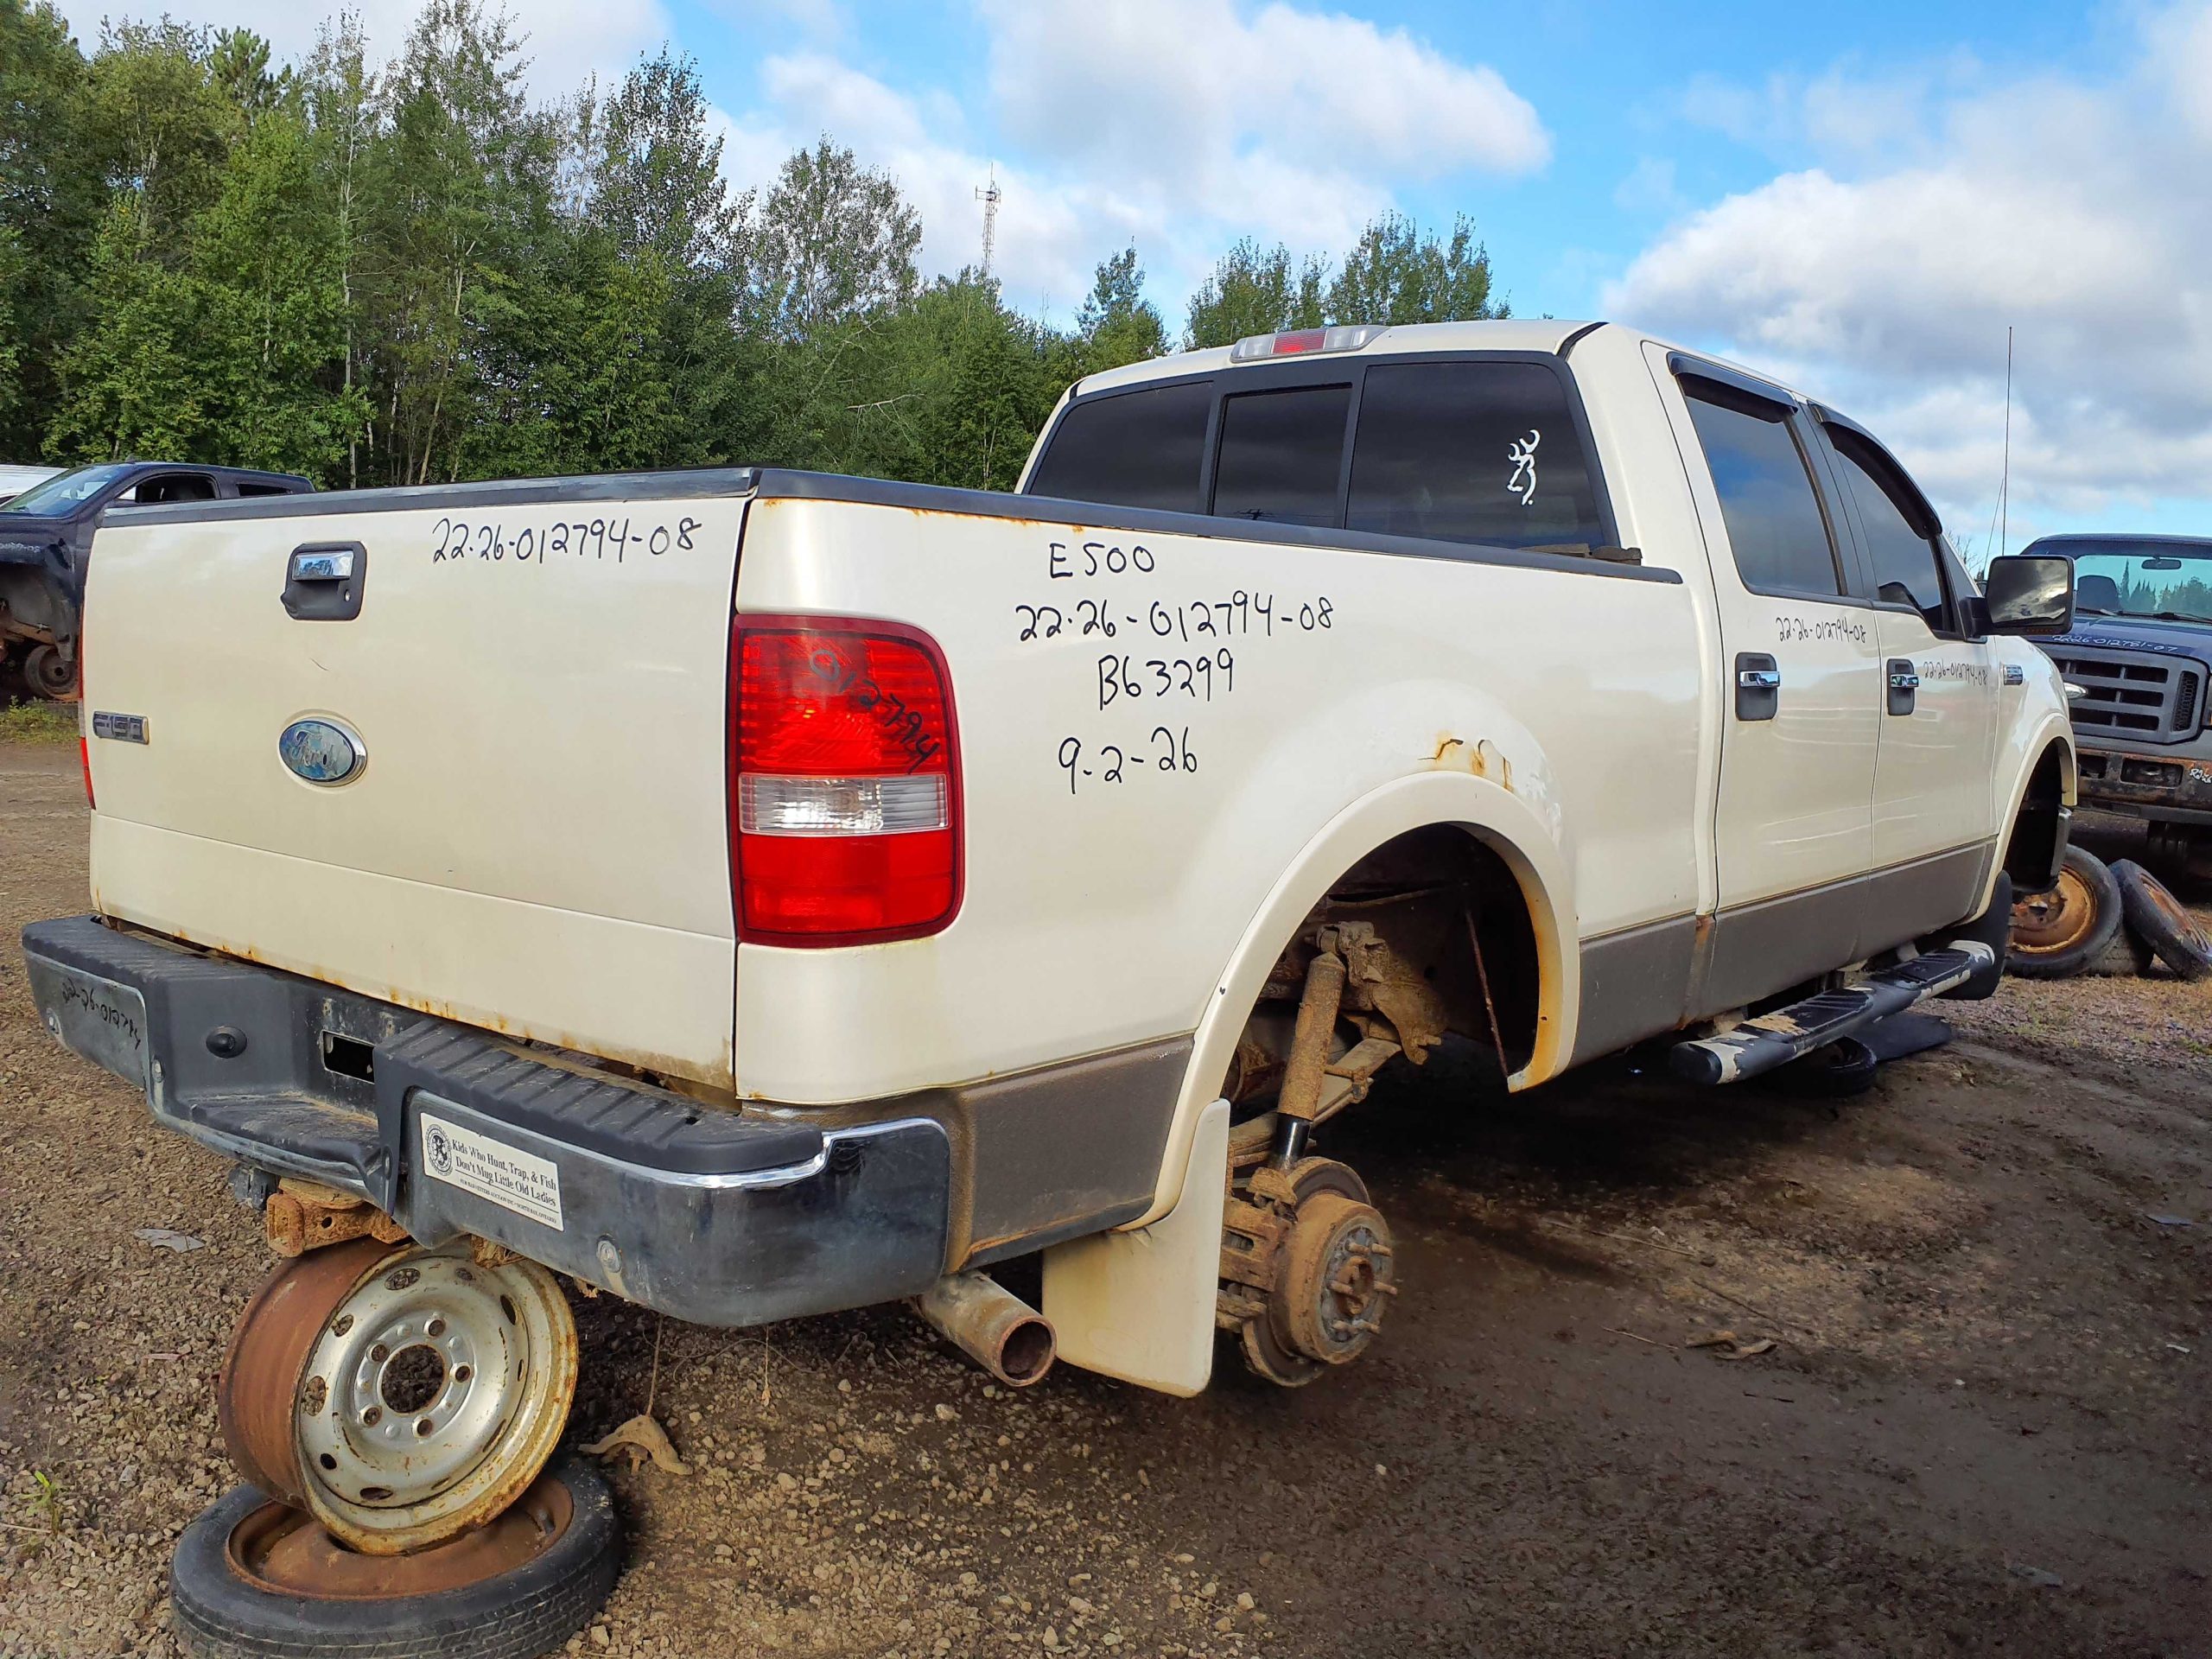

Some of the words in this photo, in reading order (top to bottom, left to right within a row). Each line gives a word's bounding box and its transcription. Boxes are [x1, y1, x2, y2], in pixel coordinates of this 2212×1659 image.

[1098, 647, 1234, 711] B63299
[452, 1139, 468, 1155] Kids
[469, 1147, 486, 1162] Who
[487, 1154, 508, 1173] Hunt,
[509, 1162, 529, 1182] Trap,
[531, 1171, 538, 1184] &
[540, 1174, 556, 1191] Fish
[455, 1156, 475, 1175] Don't
[476, 1164, 493, 1185] Mug
[494, 1172, 514, 1189] Little
[515, 1180, 529, 1195] Old
[531, 1186, 556, 1206] Ladies
